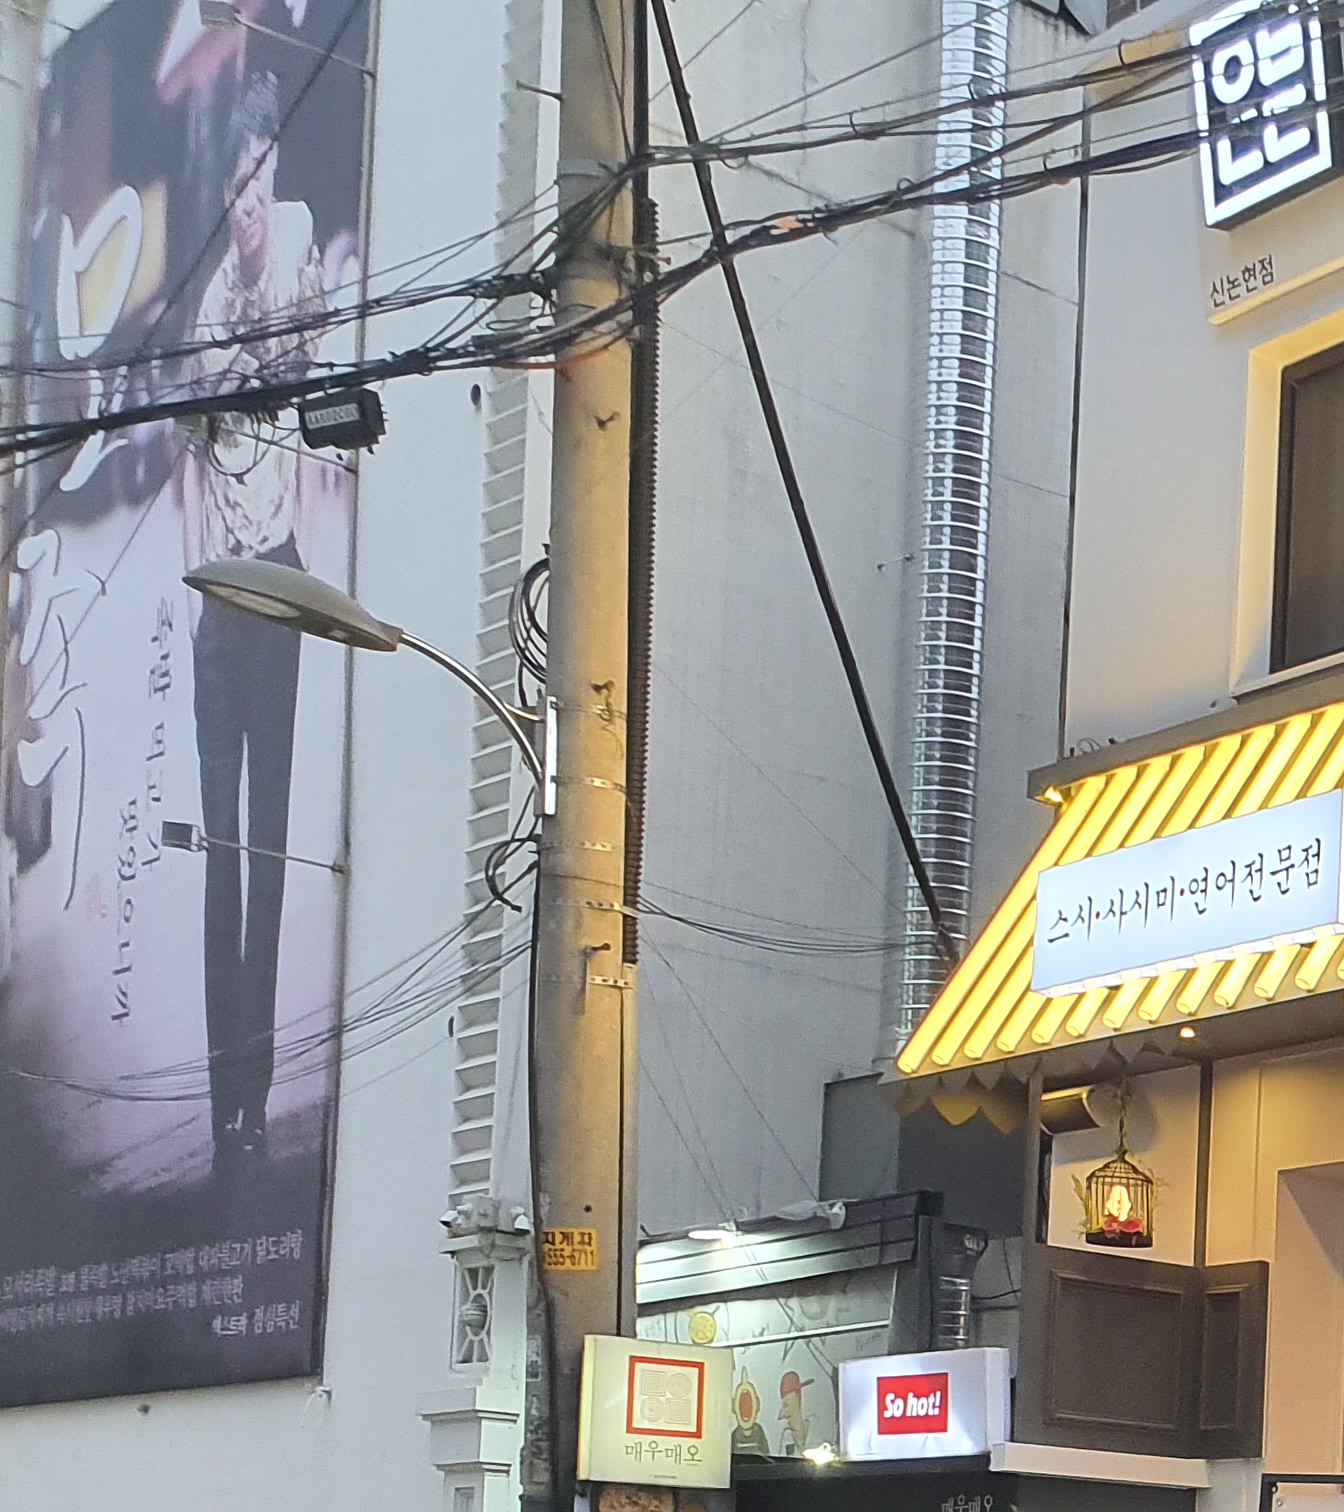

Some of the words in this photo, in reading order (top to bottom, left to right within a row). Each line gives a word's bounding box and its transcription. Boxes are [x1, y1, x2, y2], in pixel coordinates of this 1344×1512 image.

[1208, 253, 1276, 307] 신논현점
[883, 1392, 905, 1419] So
[905, 1389, 942, 1417] hot!
[624, 1440, 704, 1466] 매우매오
